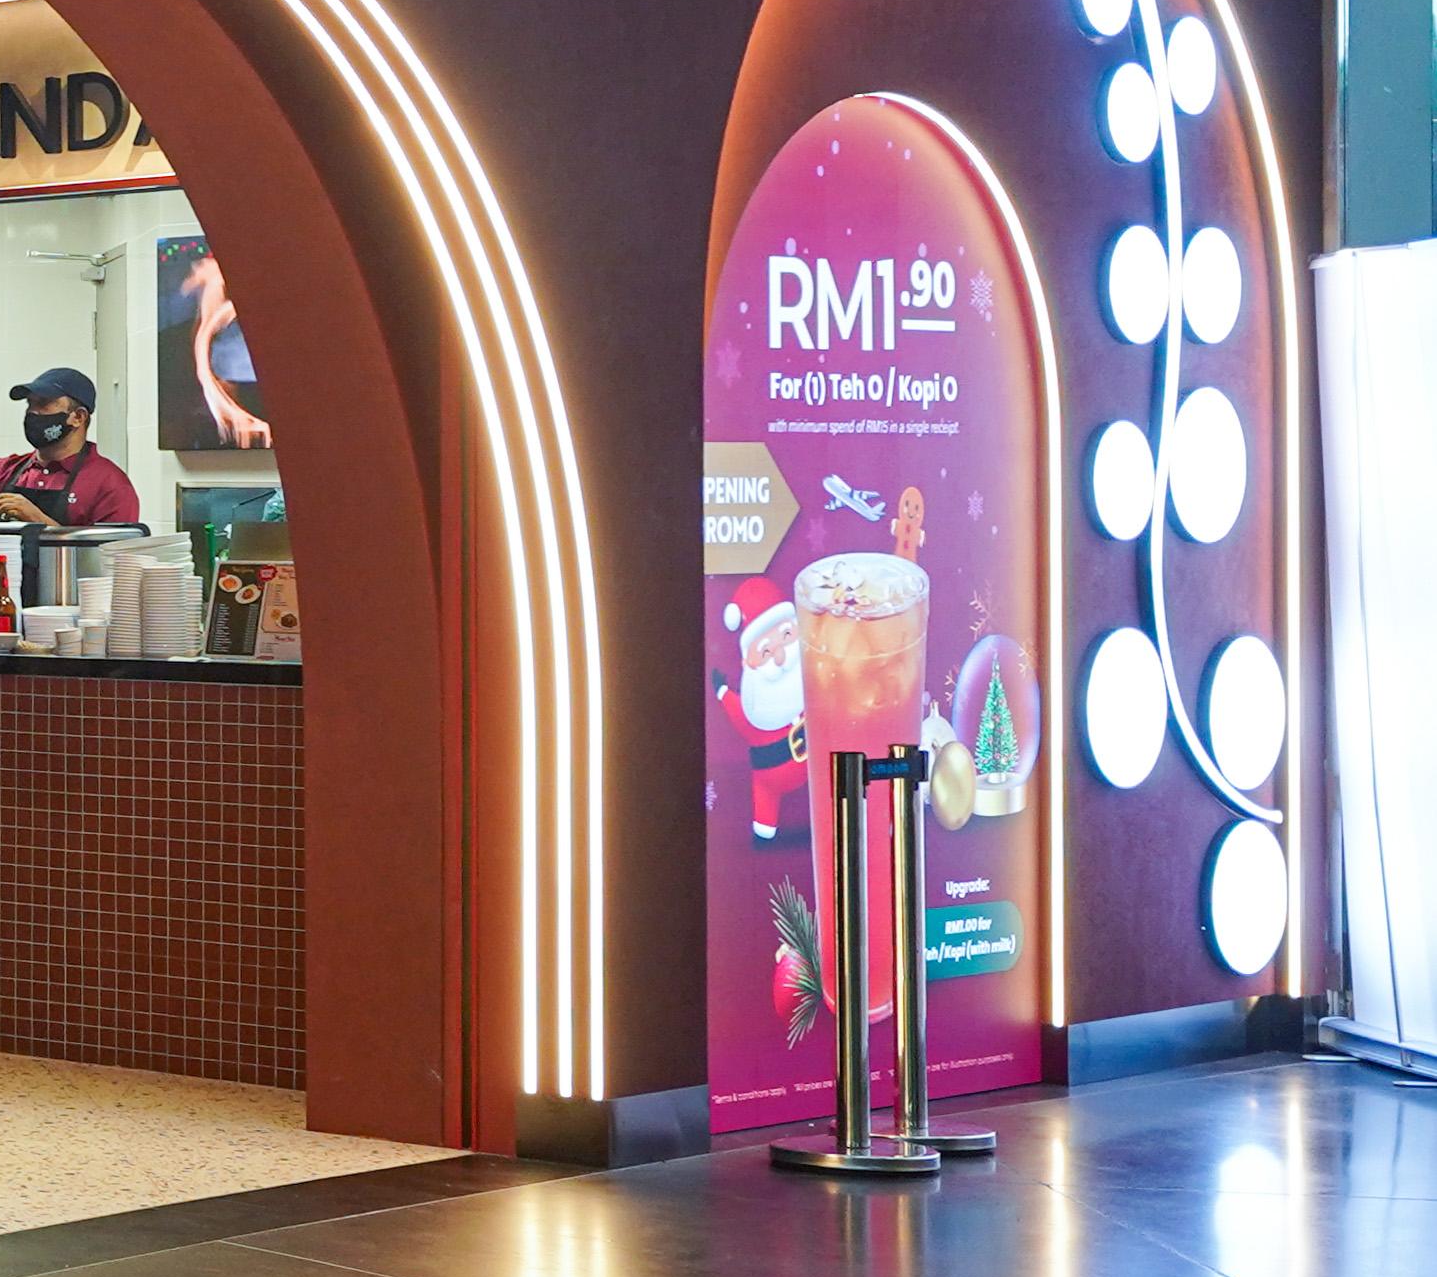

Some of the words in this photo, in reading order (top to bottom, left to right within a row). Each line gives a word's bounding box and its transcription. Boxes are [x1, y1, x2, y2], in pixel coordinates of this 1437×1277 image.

[768, 255, 956, 351] RM1.90
[769, 372, 802, 399] For
[804, 371, 826, 405] (1)
[829, 373, 865, 400] Teh
[886, 366, 896, 407] /
[898, 372, 940, 410] Kopi
[829, 419, 855, 435] spend
[856, 419, 866, 433] of
[906, 419, 929, 436] single
[703, 476, 770, 504] PENING
[704, 515, 764, 544] ROMO
[945, 877, 990, 898] Upgrade:
[978, 916, 992, 931] for
